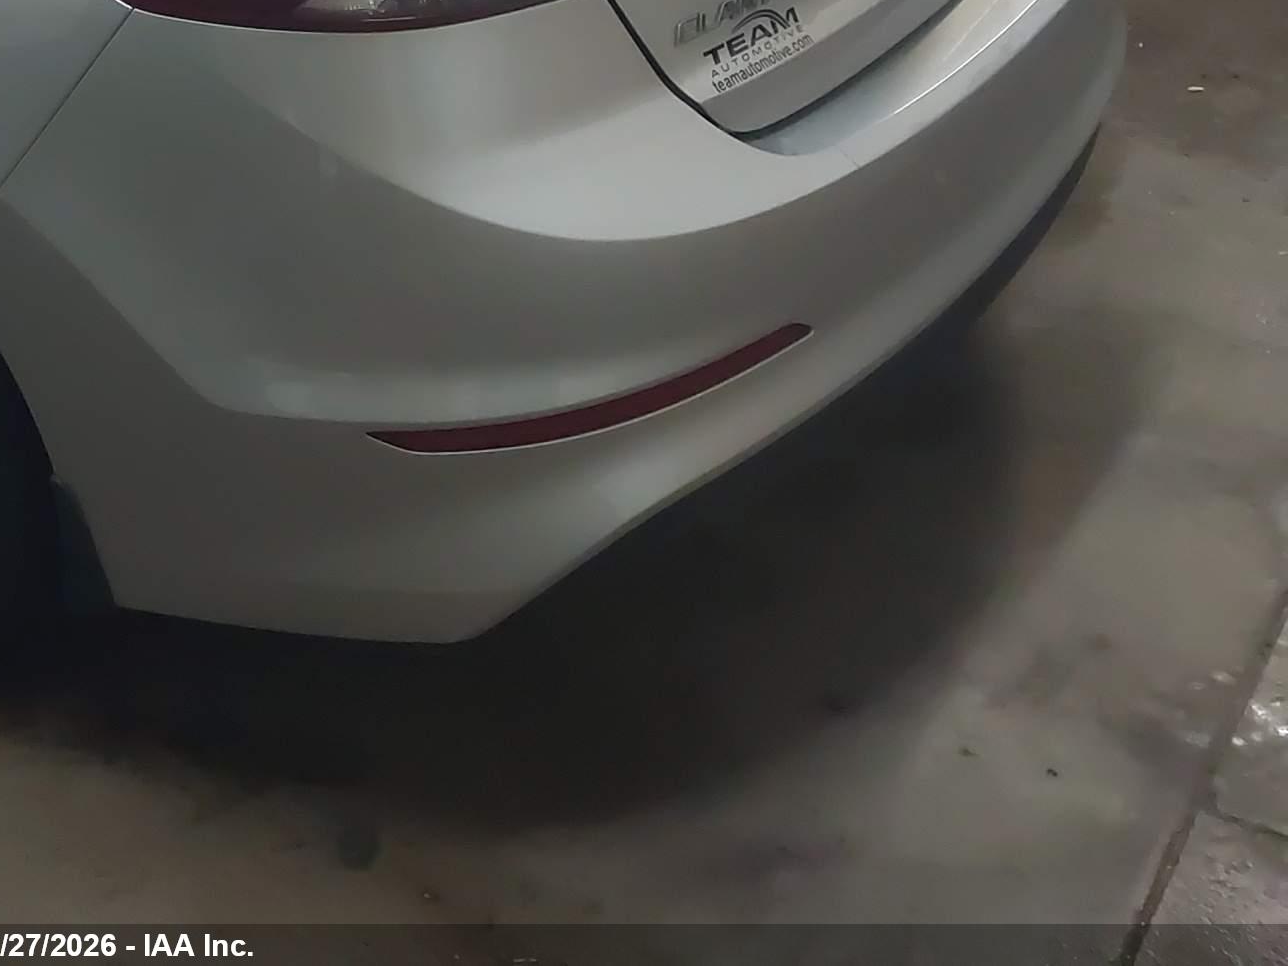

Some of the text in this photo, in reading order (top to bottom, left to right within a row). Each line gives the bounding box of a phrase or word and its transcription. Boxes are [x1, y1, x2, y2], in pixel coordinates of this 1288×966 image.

[703, 7, 800, 65] TEAM
[711, 23, 804, 79] AUTOMOTIVE
[711, 33, 816, 94] teamautomotive.com
